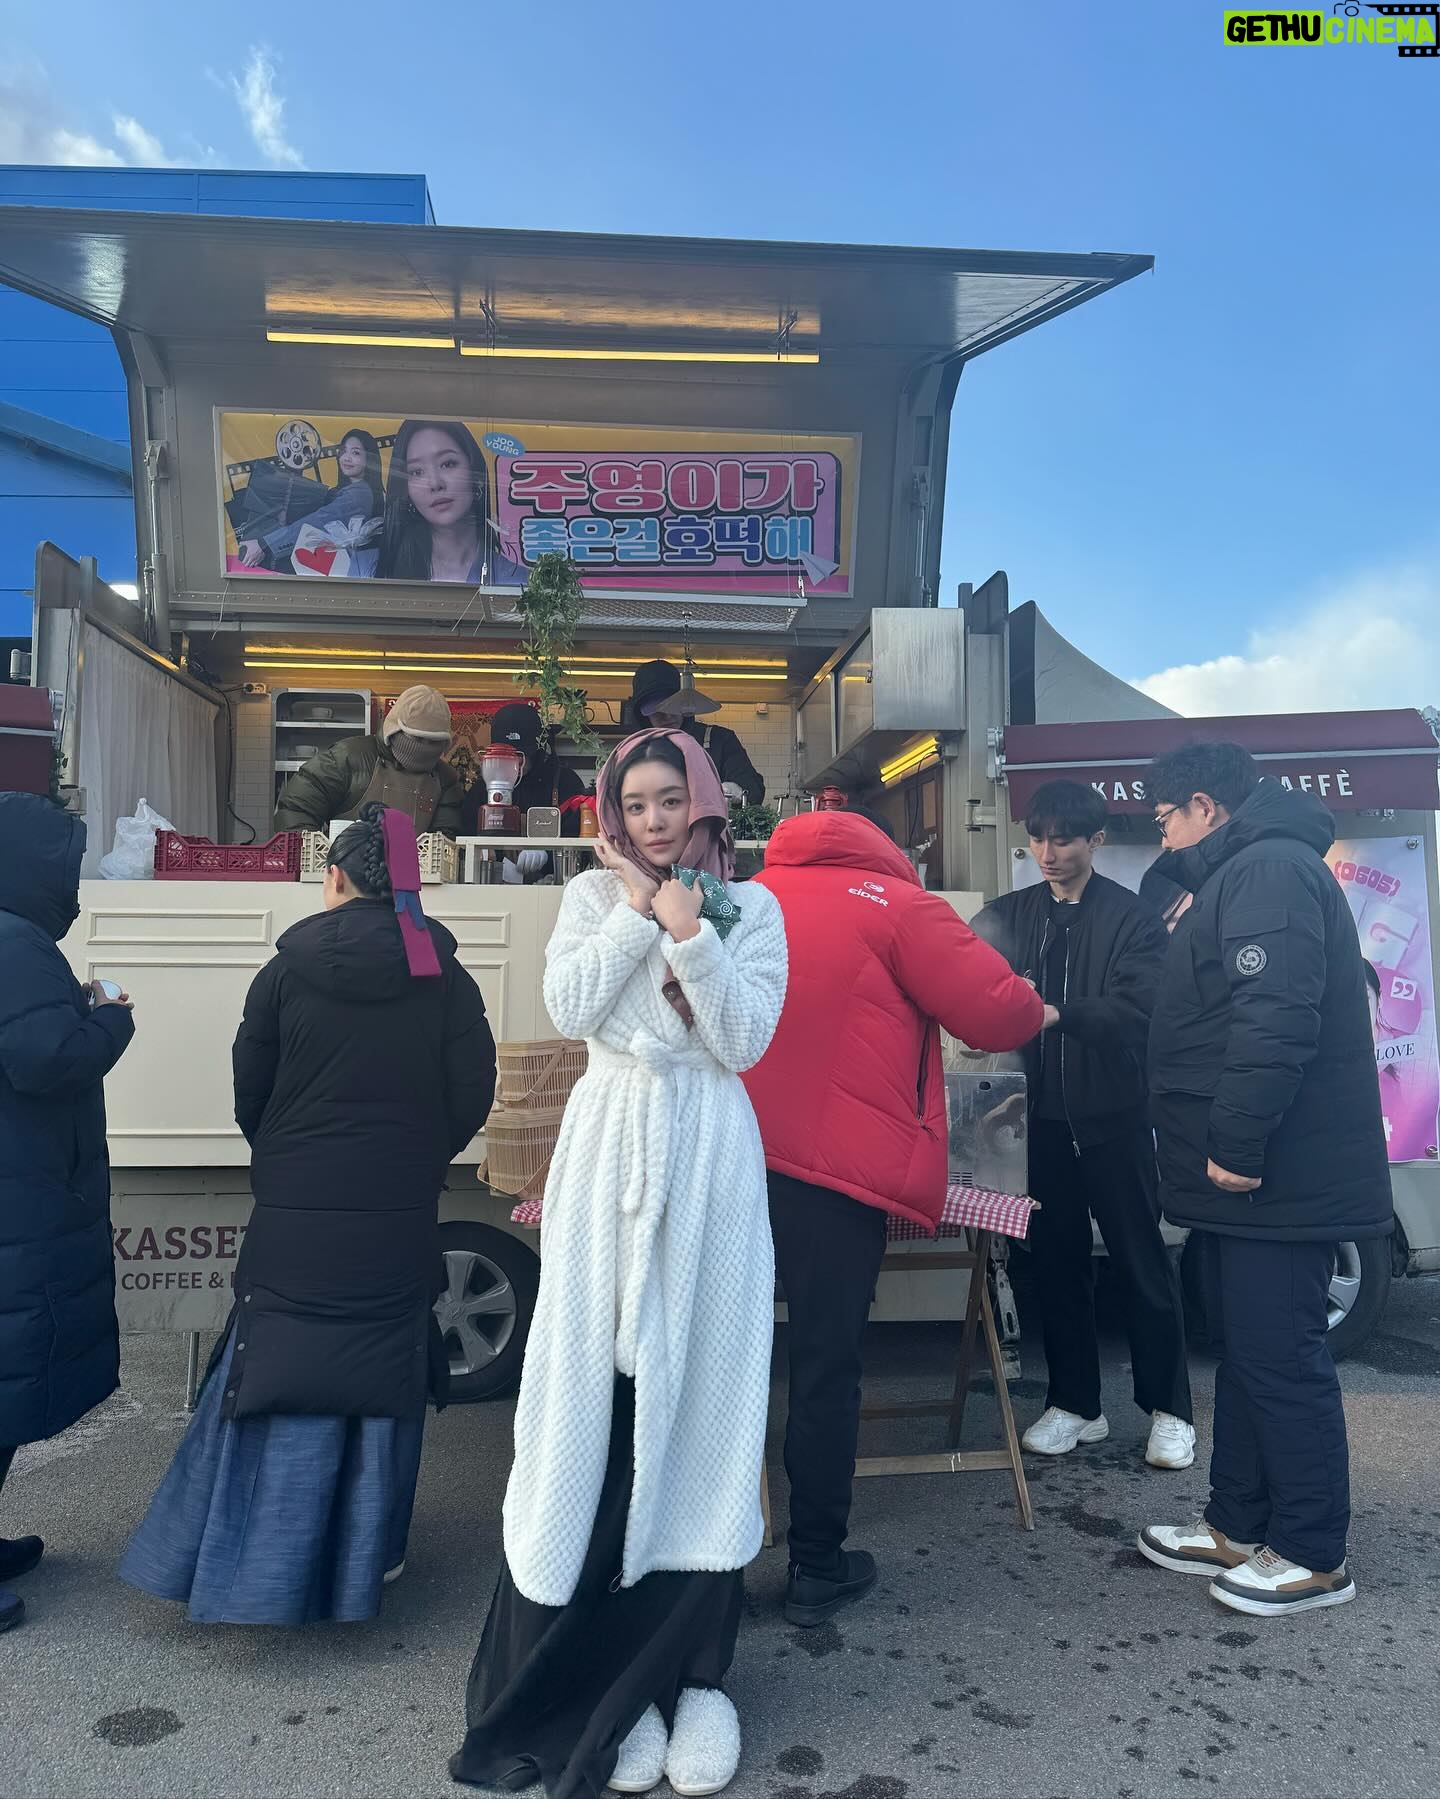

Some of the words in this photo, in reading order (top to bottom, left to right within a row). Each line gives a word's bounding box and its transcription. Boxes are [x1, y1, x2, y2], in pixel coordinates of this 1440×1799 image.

[486, 440, 519, 456] YOUNG
[511, 459, 826, 513] 주영이가
[1259, 769, 1353, 797] AFFÈ
[1376, 1042, 1415, 1061] LOVE
[112, 1226, 249, 1261] KASSE
[121, 1272, 203, 1291] COFFEE
[208, 1271, 224, 1289] &
